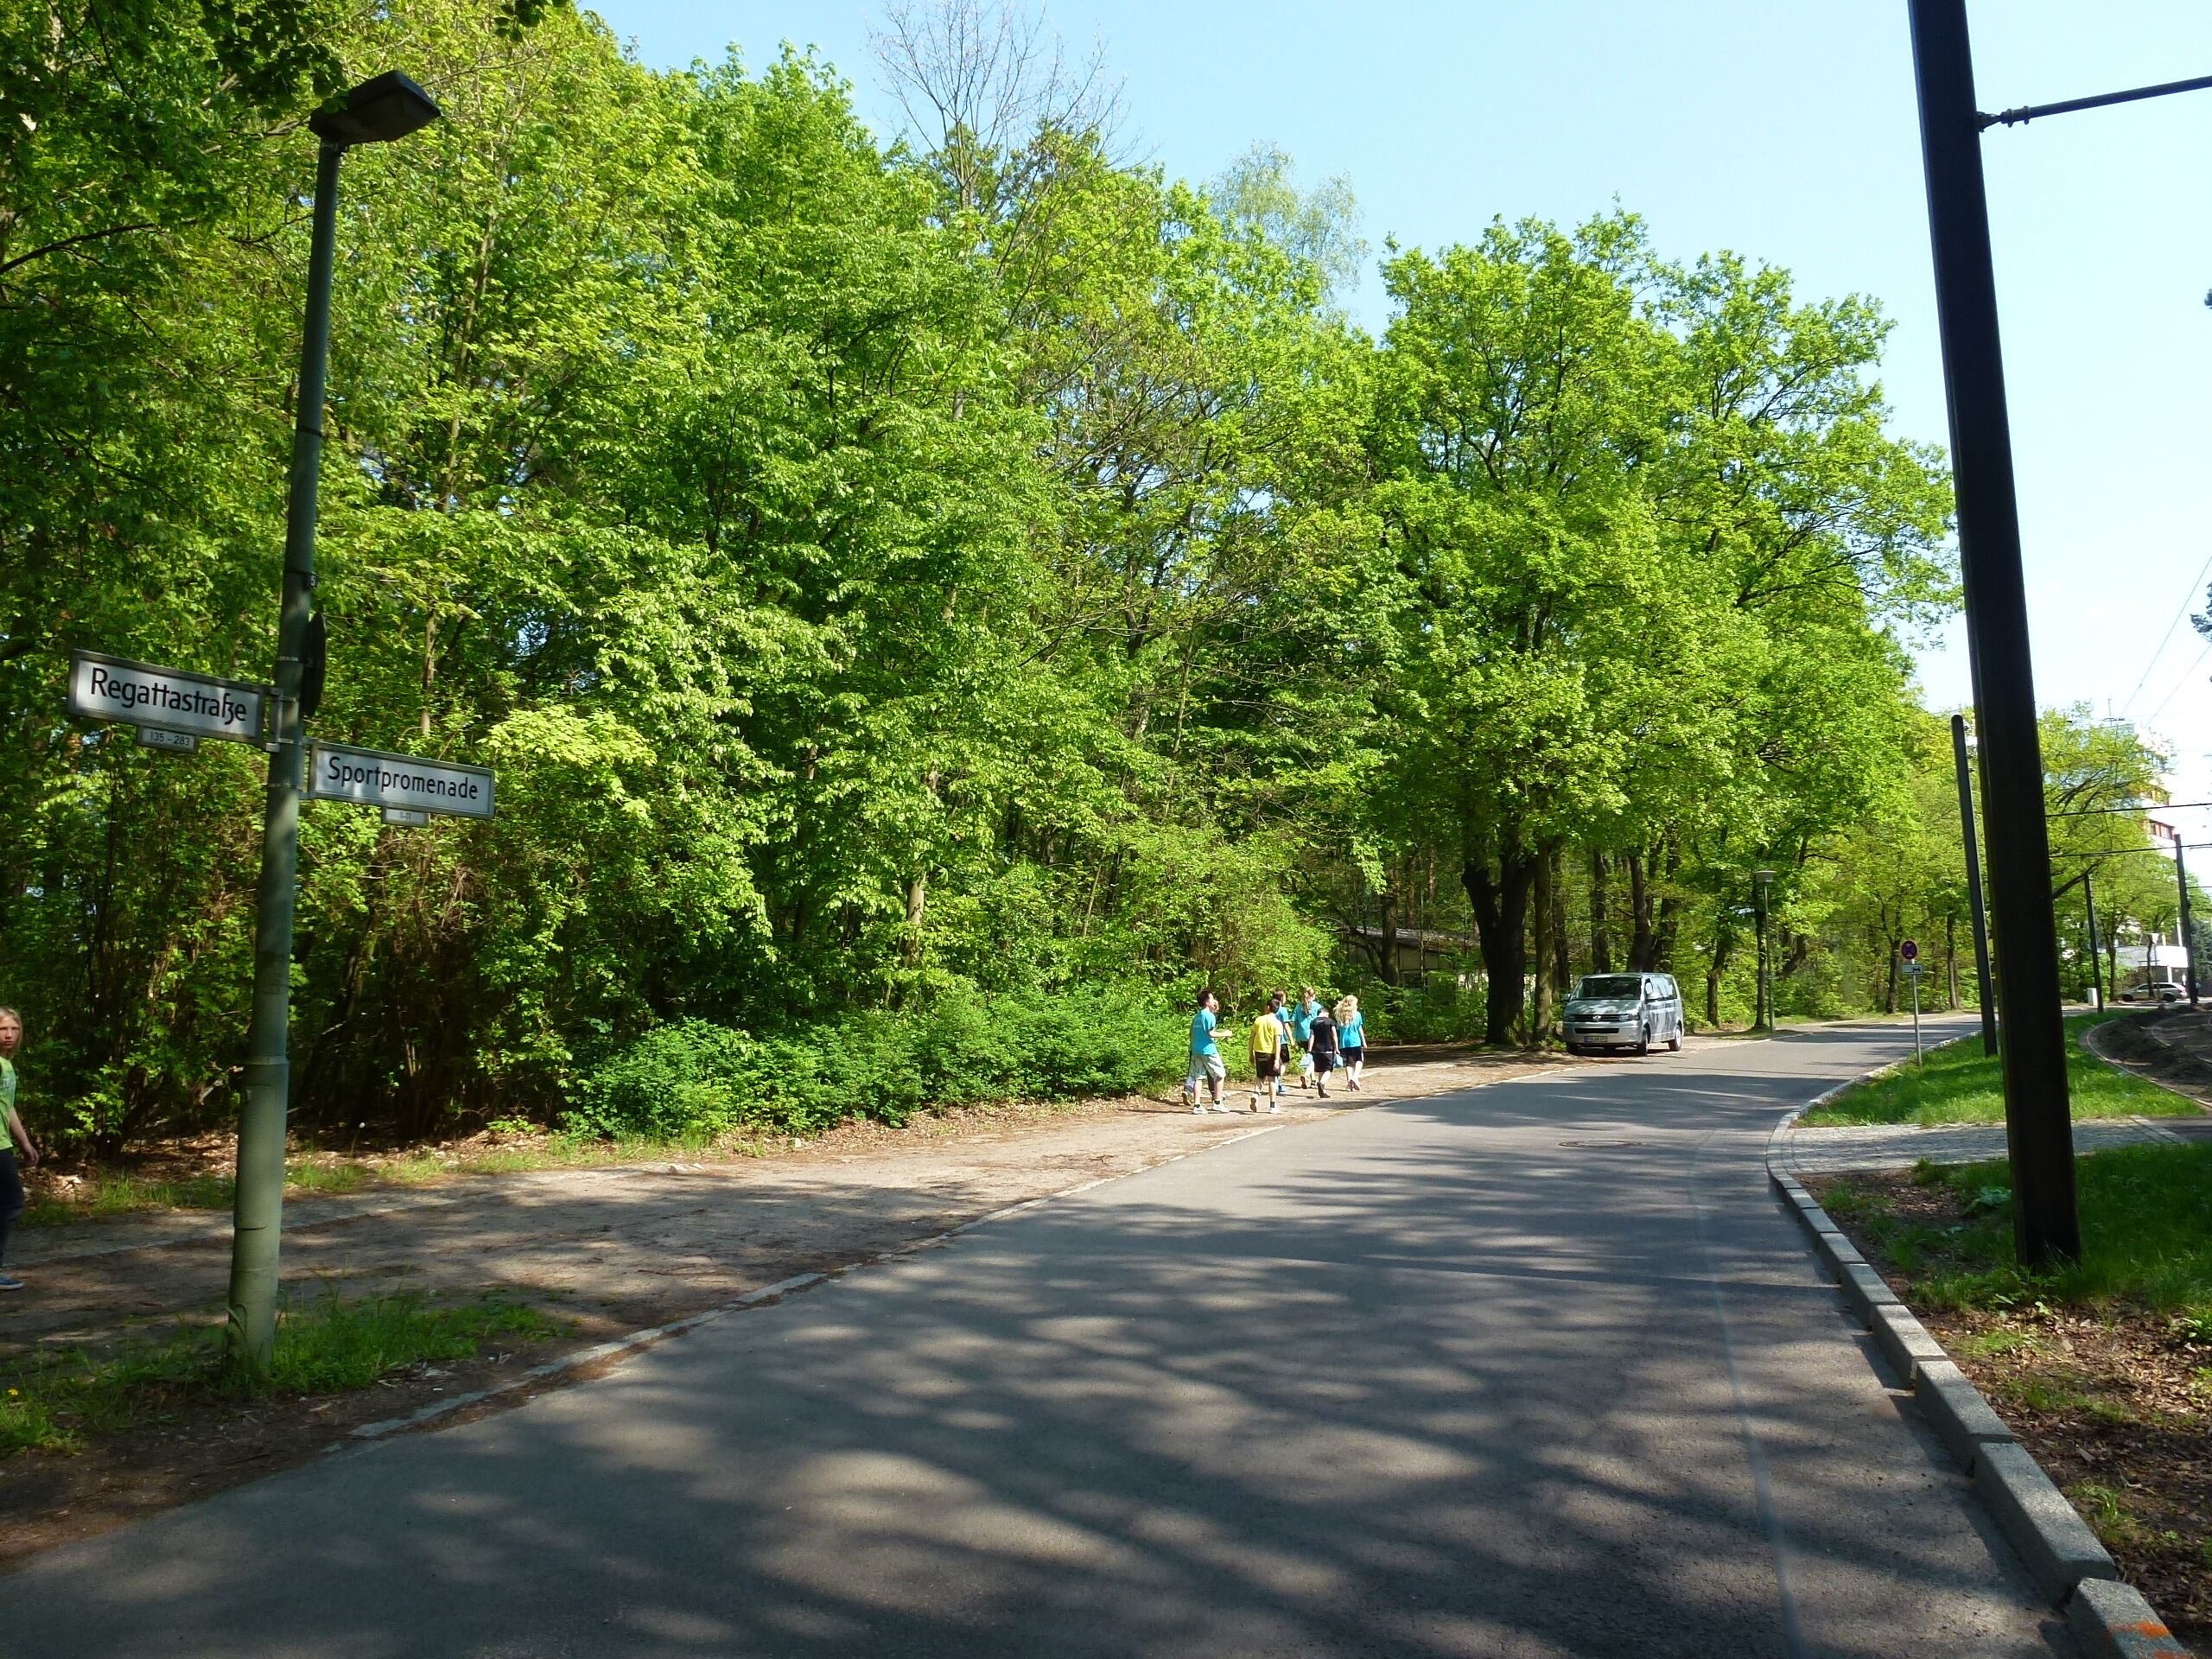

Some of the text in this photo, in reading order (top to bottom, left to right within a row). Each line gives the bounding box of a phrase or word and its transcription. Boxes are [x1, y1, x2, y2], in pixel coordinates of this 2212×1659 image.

[91, 667, 247, 725] Regattastraße
[149, 731, 165, 742] 135
[174, 734, 190, 747] 283
[327, 756, 479, 800] Sportpromenade
